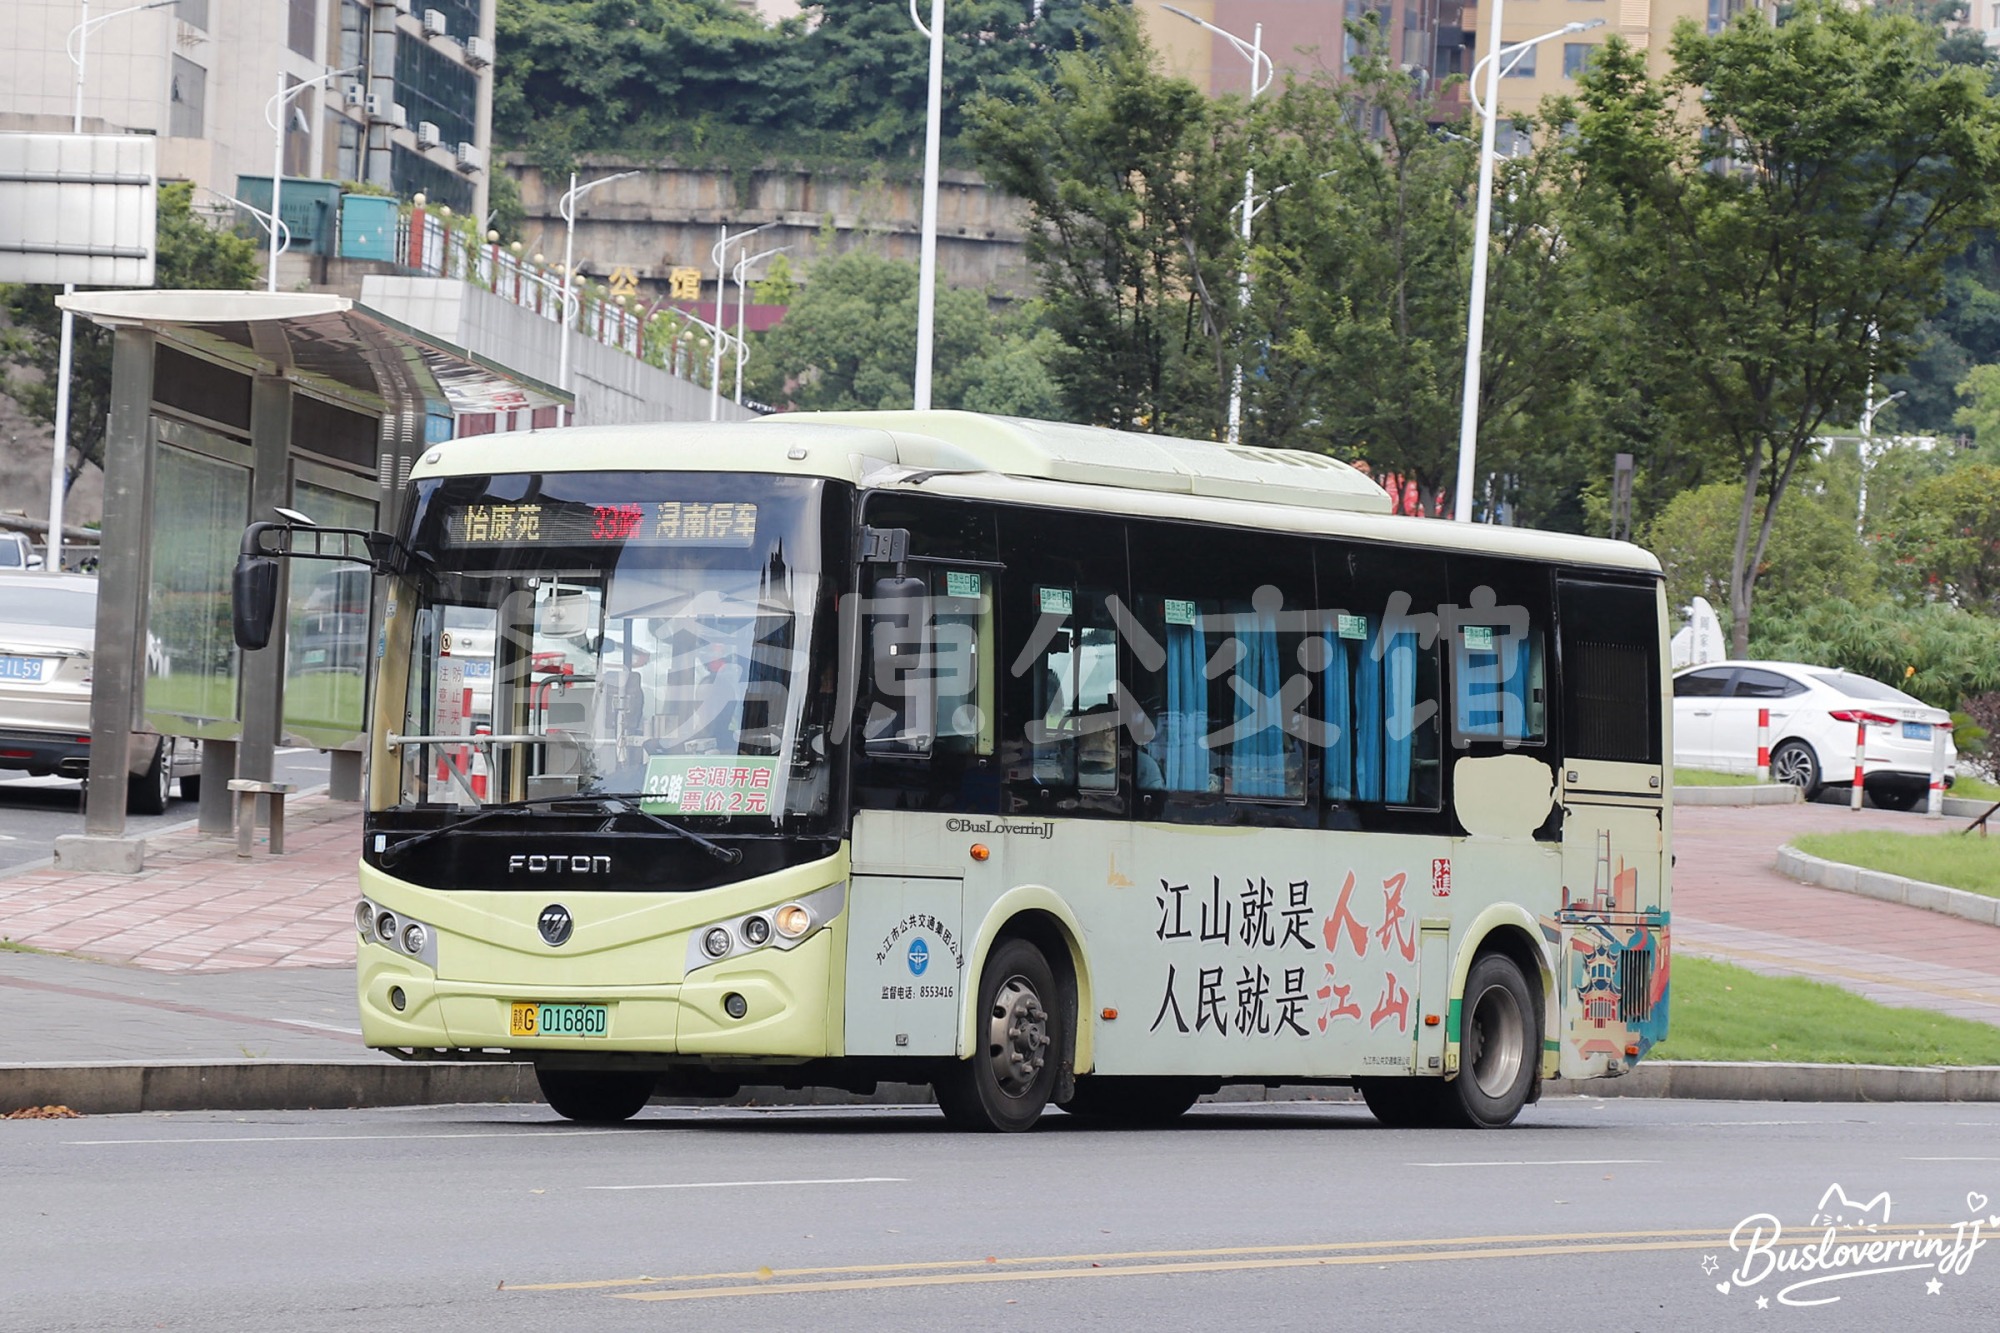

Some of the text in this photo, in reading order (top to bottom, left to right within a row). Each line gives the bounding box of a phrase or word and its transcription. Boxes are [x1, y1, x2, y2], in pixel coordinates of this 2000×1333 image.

[464, 504, 542, 541] 怡康苑
[592, 502, 644, 540] 33路
[656, 501, 757, 539] 浔南停车
[645, 773, 684, 804] 33路
[685, 767, 771, 788] 空调开启
[680, 791, 767, 813] 票价2元
[508, 854, 612, 873] FOTON
[1155, 869, 1416, 962] 江山就是人民
[876, 913, 965, 970] 九江市公共交通集团公司
[1149, 962, 1410, 1038] 人民就是江山
